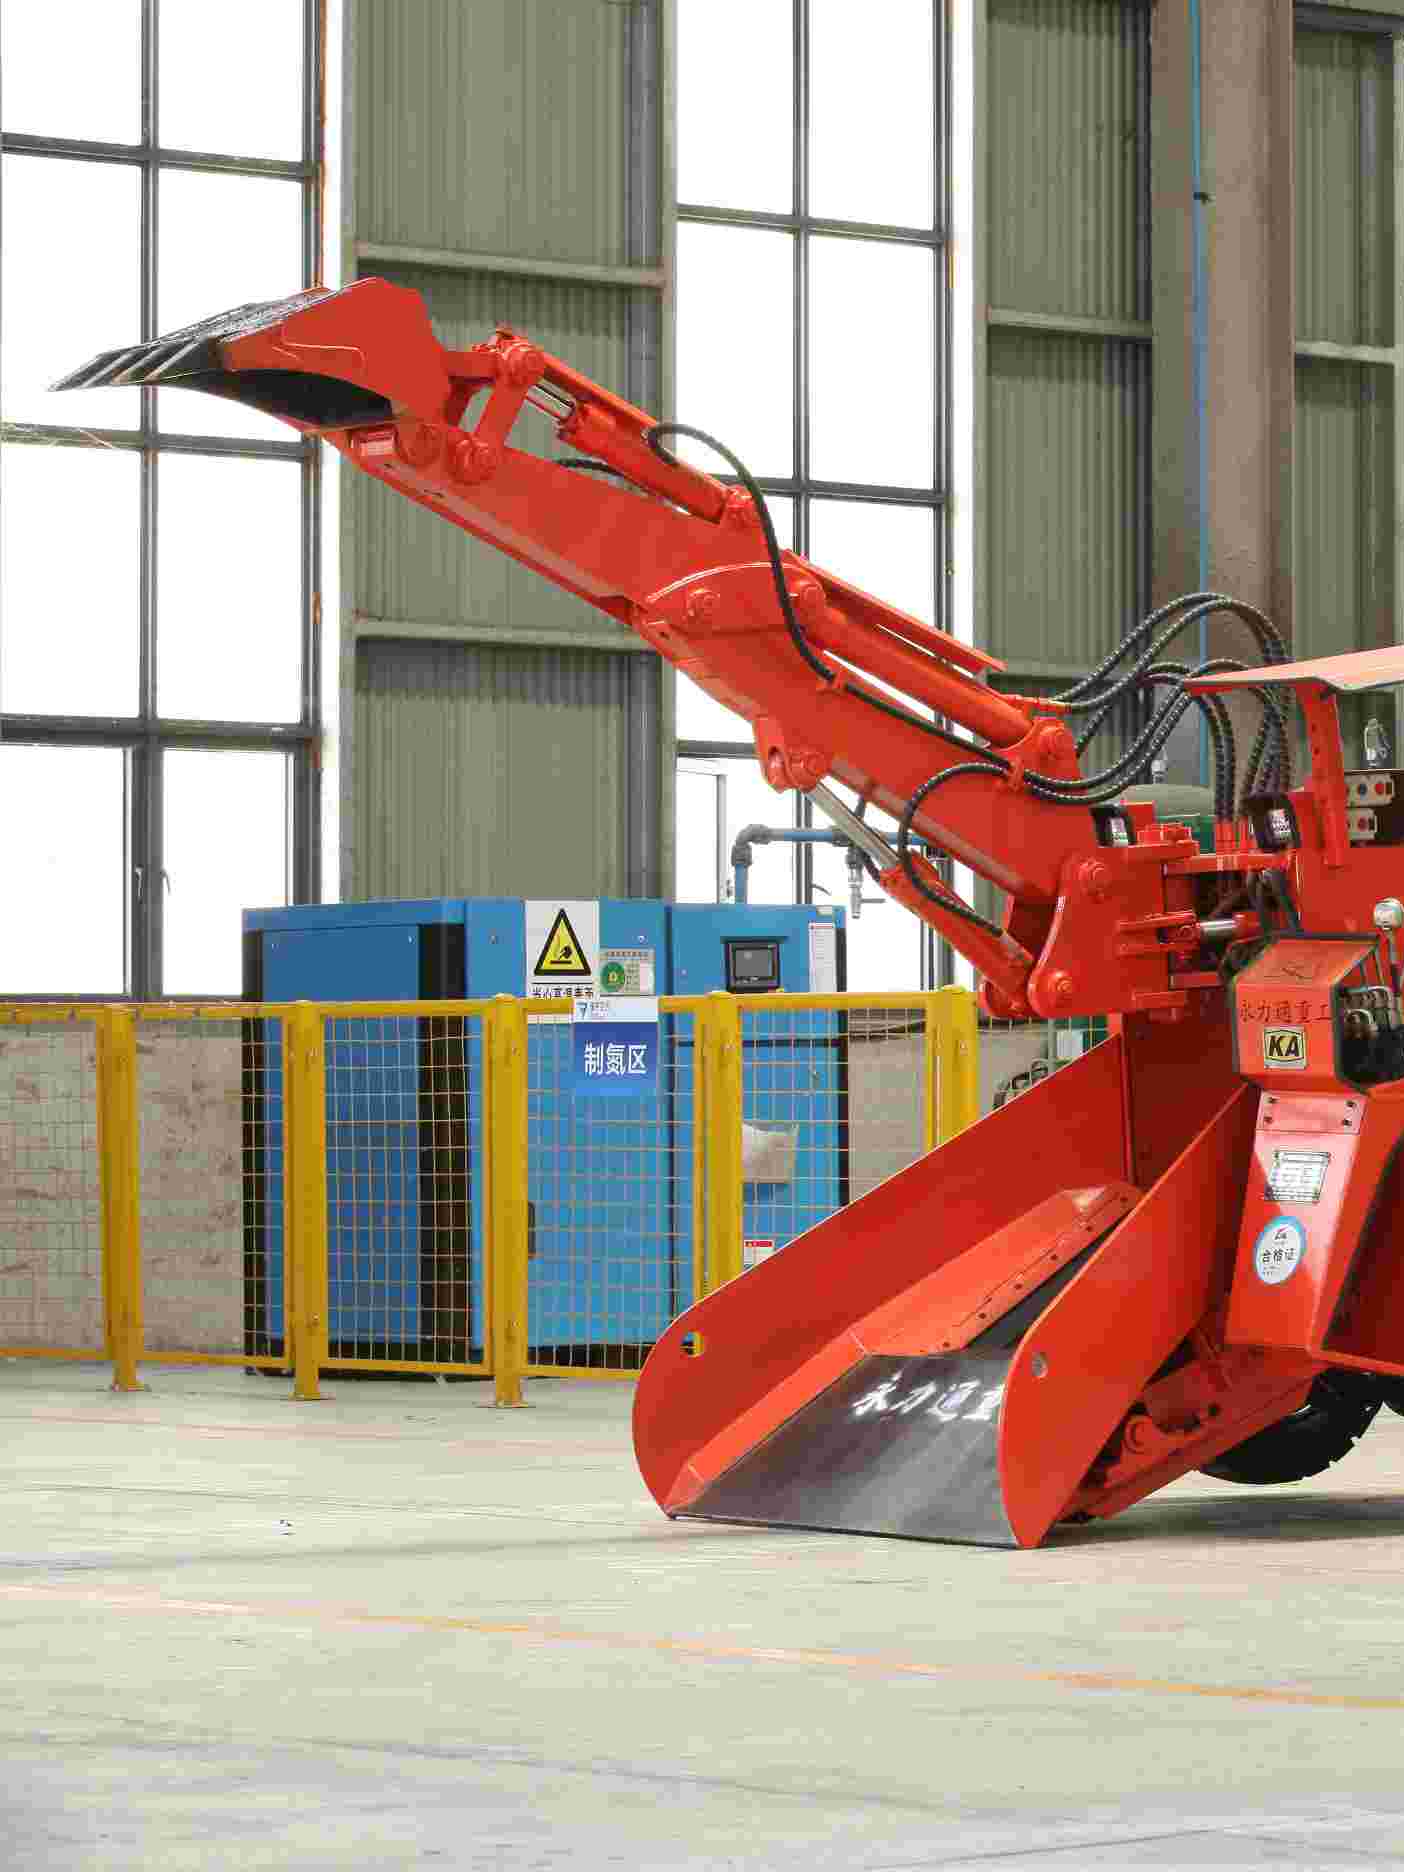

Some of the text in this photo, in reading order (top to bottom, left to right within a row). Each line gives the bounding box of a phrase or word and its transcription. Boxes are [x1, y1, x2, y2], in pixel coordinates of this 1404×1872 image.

[583, 1040, 648, 1076] 制氮区
[1269, 1035, 1300, 1057] KA
